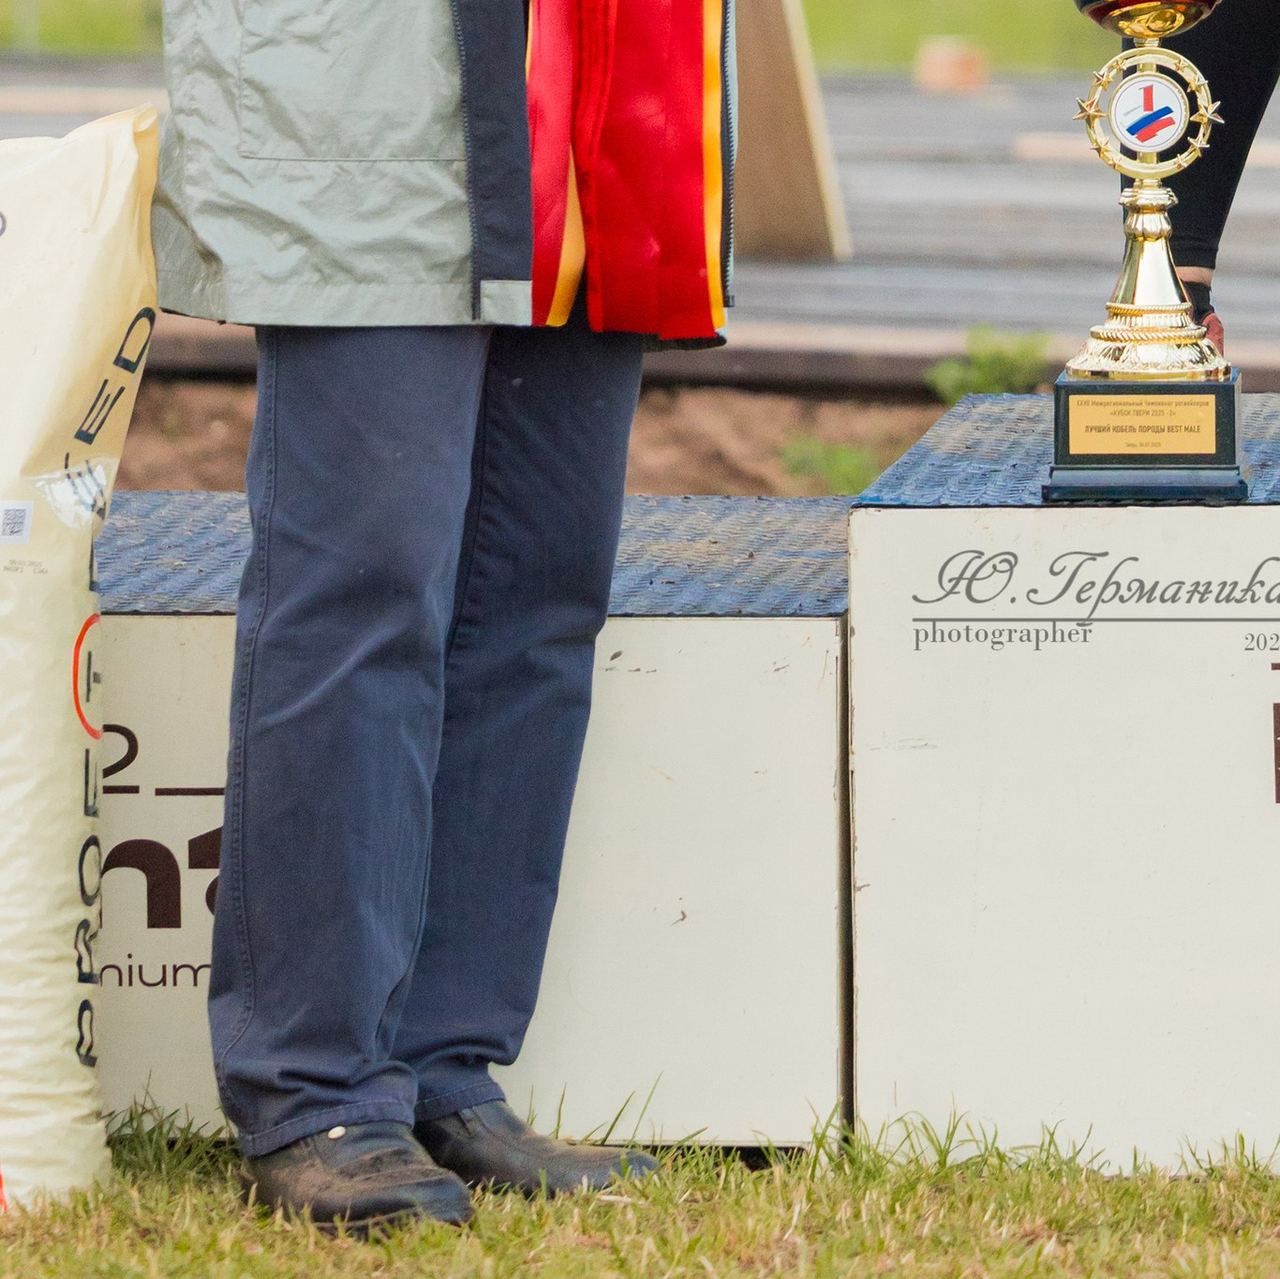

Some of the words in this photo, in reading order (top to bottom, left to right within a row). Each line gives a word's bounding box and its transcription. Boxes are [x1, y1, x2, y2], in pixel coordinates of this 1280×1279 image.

[1085, 424, 1111, 433] ЛУЧШИЙ
[1112, 425, 1137, 433] КОБЕЛЬ
[1138, 425, 1165, 434] ПОРОДЫ
[1167, 425, 1182, 433] BEST
[1184, 425, 1201, 433] MALE
